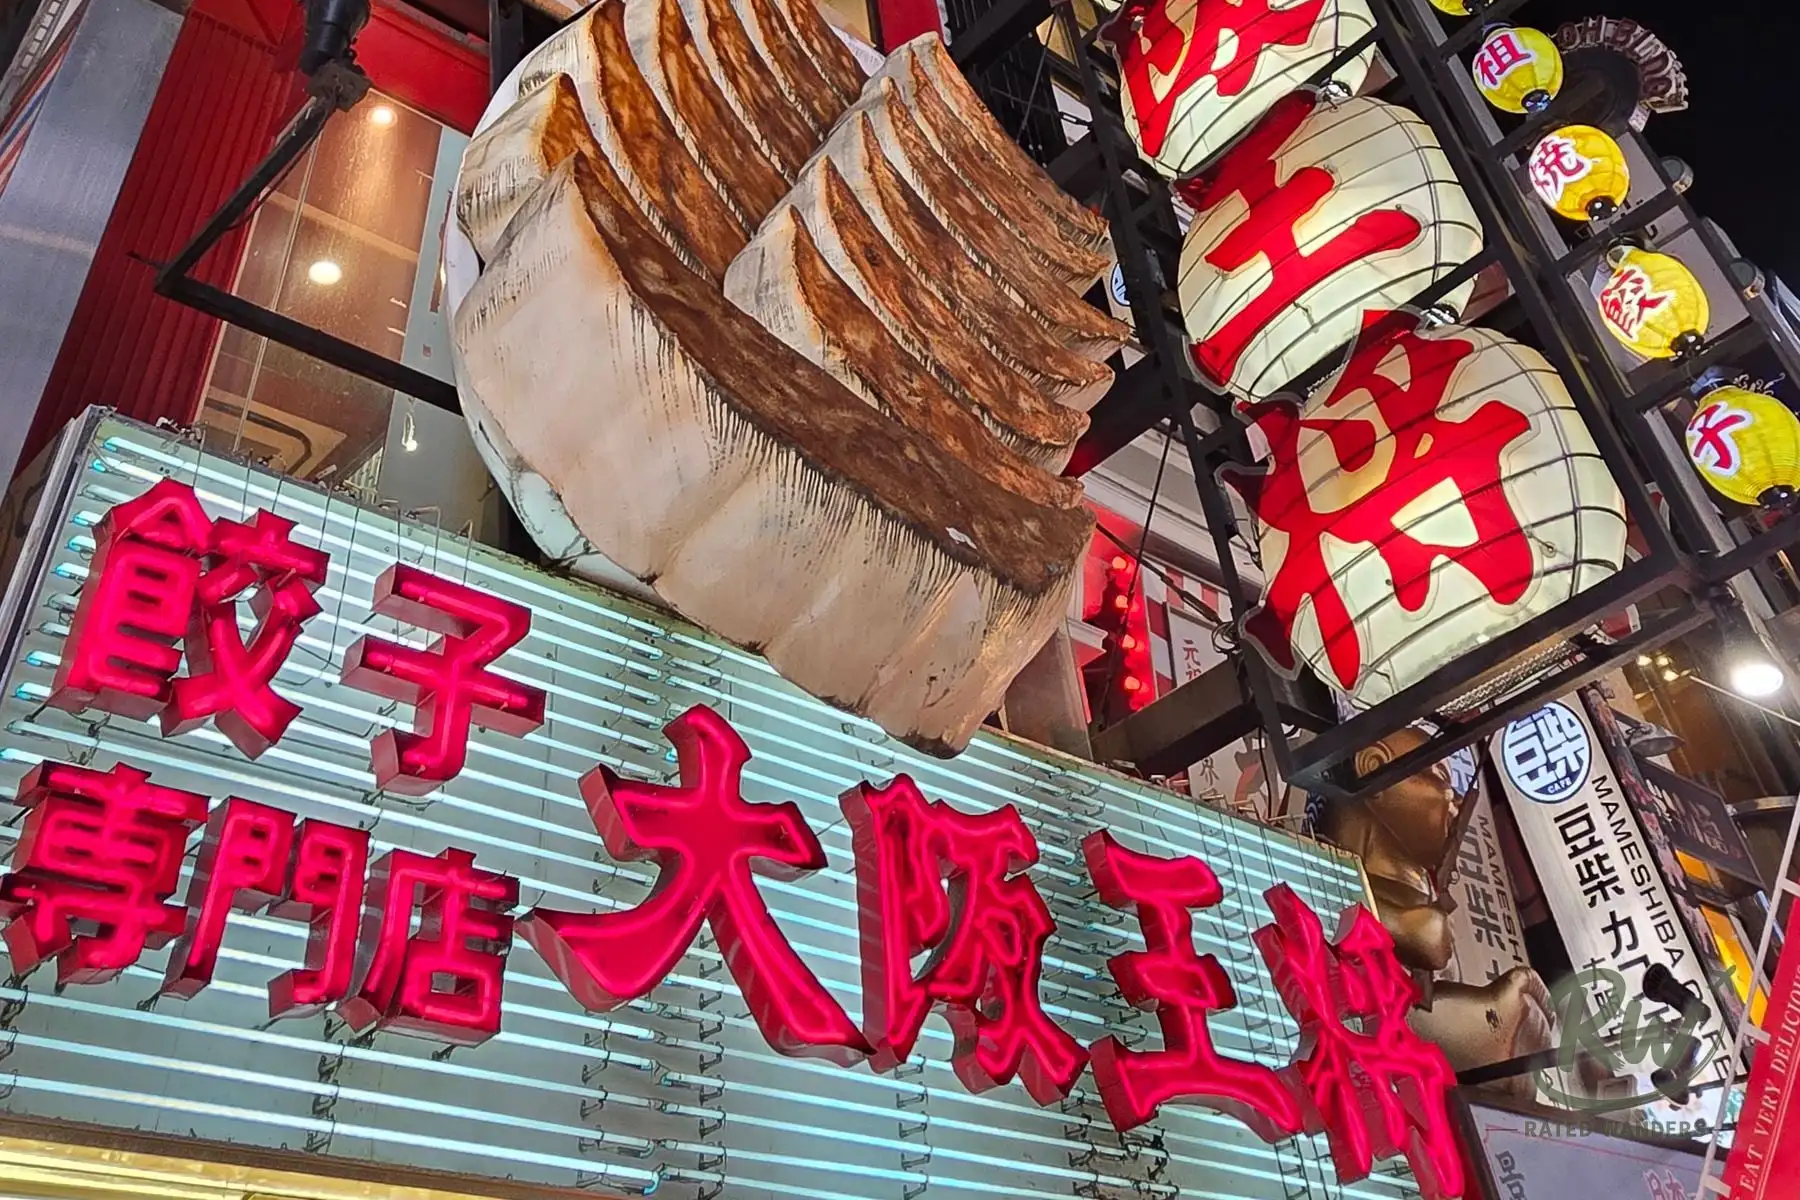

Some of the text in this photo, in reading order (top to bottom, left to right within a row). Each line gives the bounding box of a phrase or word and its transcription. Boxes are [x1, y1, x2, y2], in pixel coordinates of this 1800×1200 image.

[53, 478, 546, 793] 餃子
[1, 761, 519, 1048] 専門店
[1592, 775, 1685, 969] MAMESHIBA
[1739, 1144, 1764, 1193] EAT
[1753, 1078, 1781, 1136] VERY
